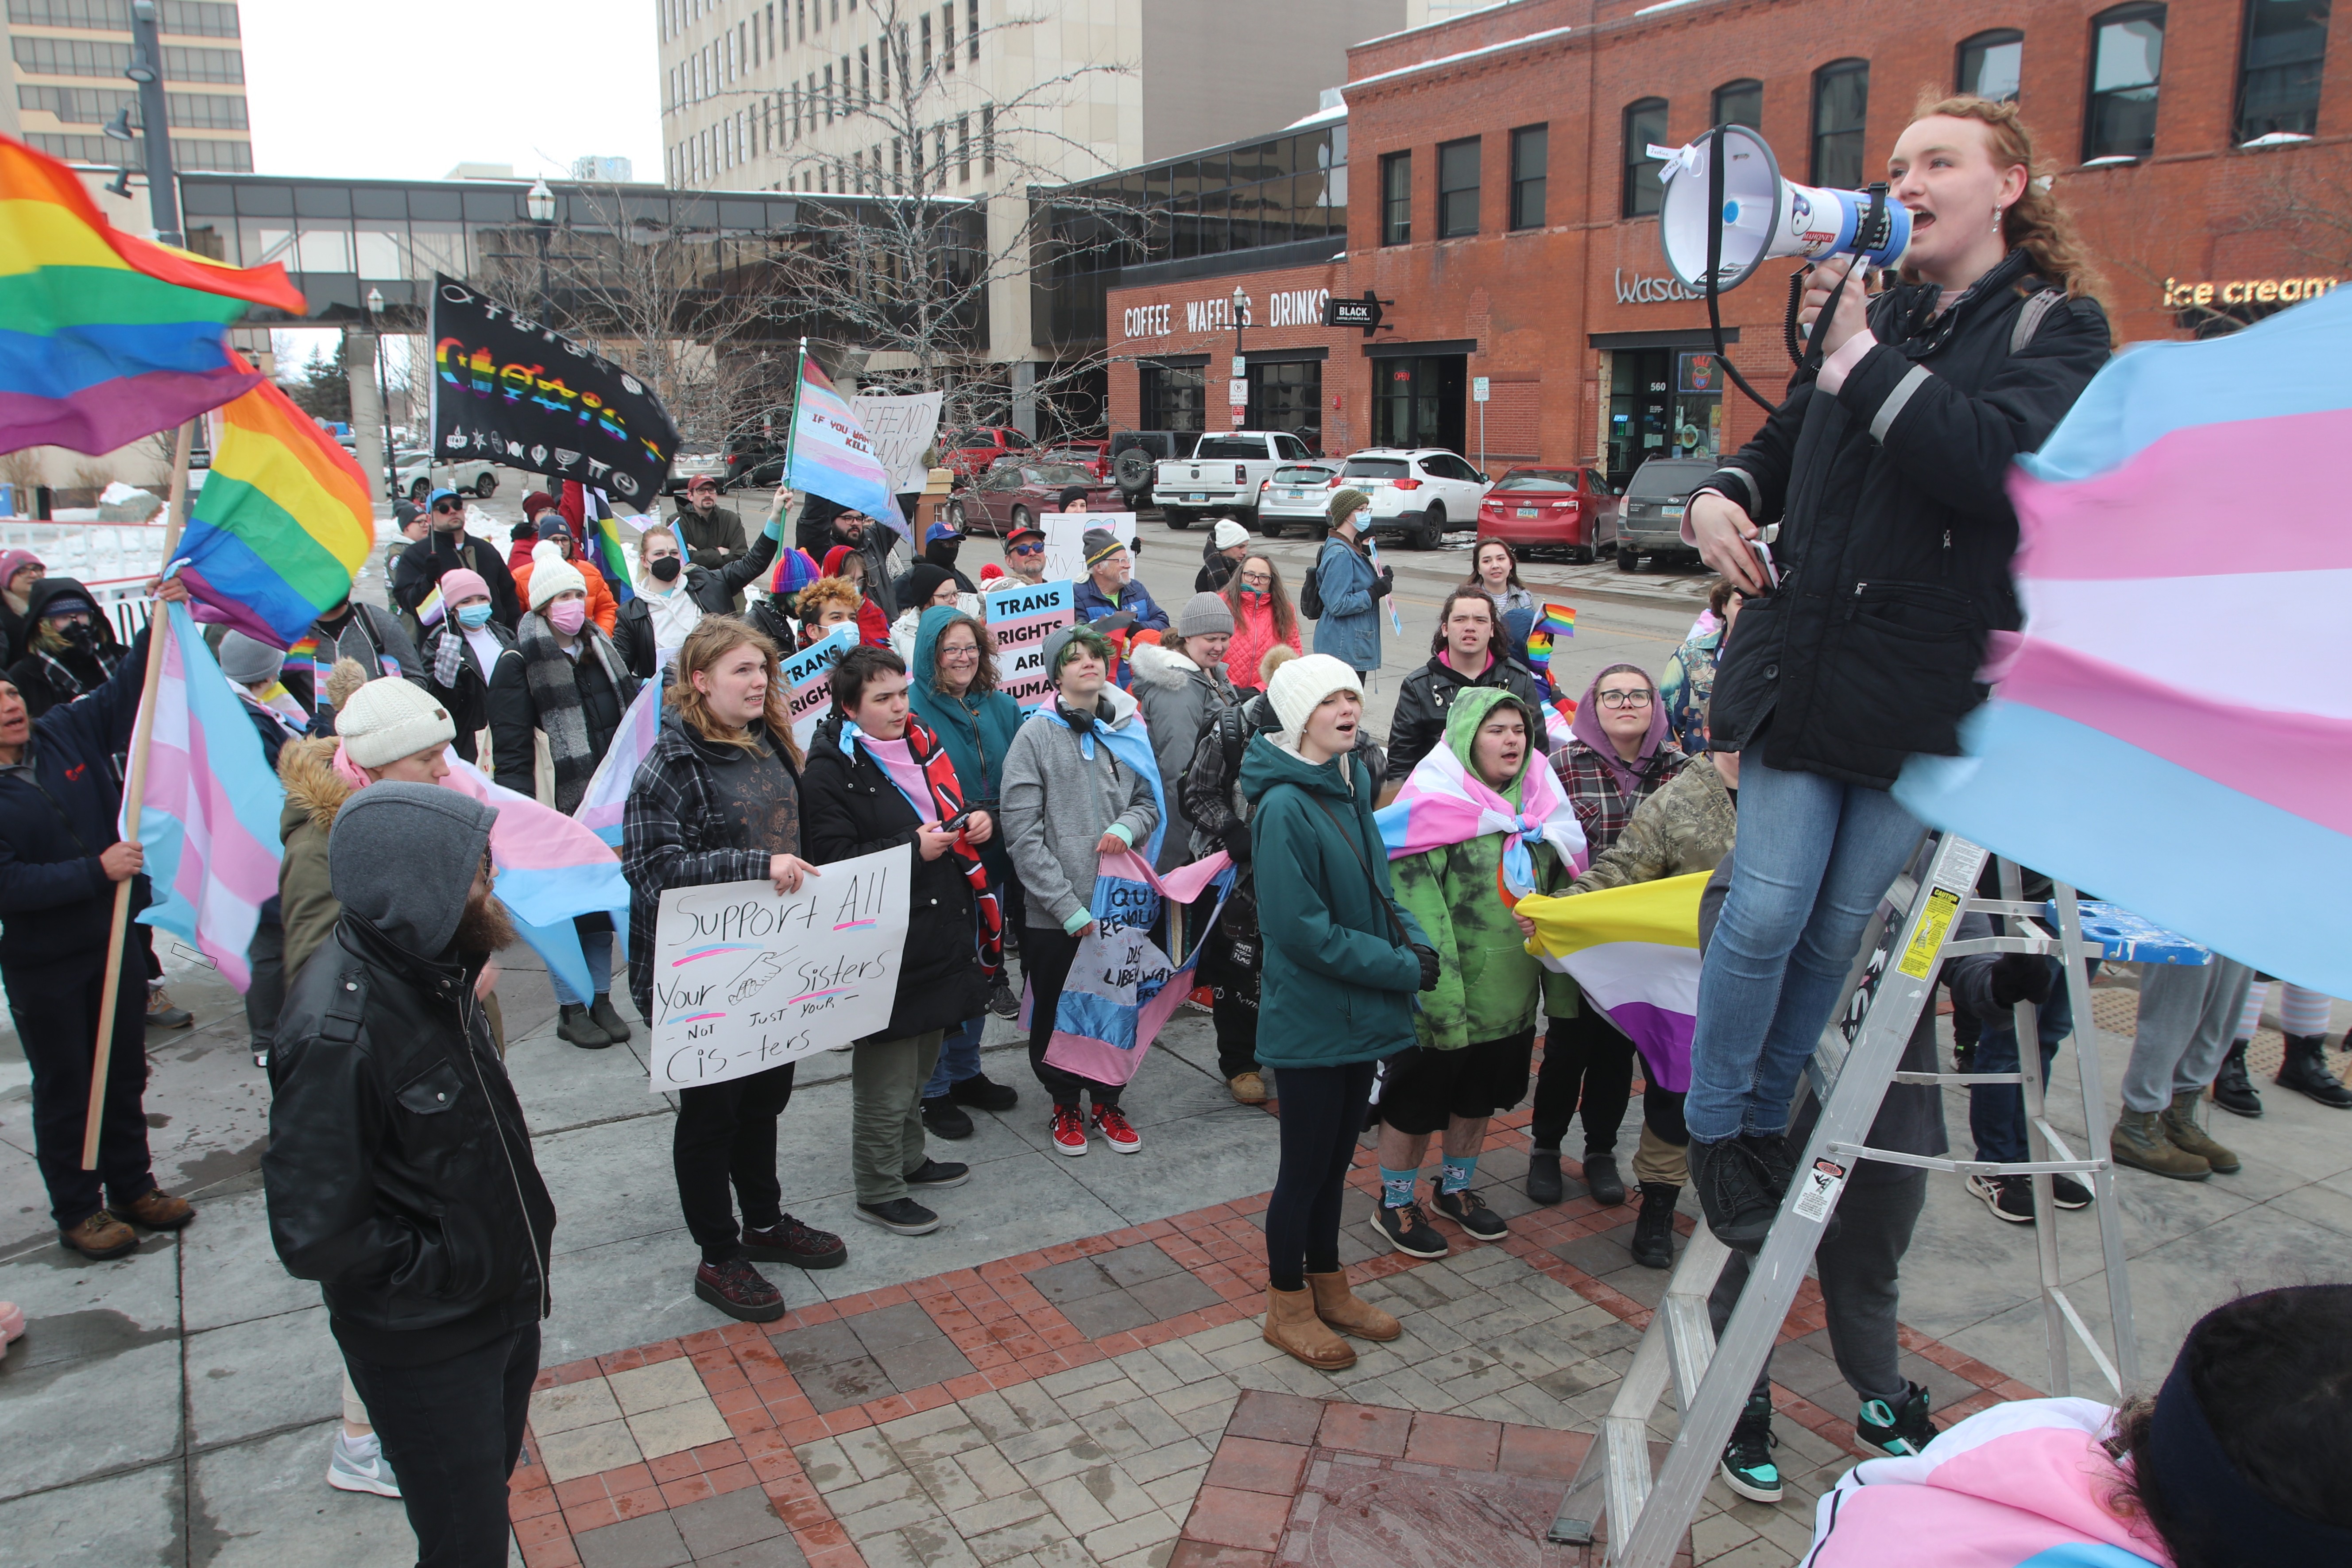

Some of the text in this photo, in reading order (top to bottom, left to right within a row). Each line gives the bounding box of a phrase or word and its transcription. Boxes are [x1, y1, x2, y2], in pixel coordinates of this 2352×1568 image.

[1650, 147, 1669, 156] Justice
[1804, 232, 1835, 242] MAHONEY
[1615, 267, 1706, 304] Wasa
[2163, 277, 2214, 306] ice
[1125, 304, 1171, 337] COFFEE
[1187, 296, 1251, 333] WAFFLS
[1339, 306, 1367, 316] BLACK
[1692, 355, 1712, 367] POKE
[1393, 372, 1410, 380] OPEN
[1650, 383, 1666, 391] 560
[812, 413, 869, 444] IF YOU WAN
[854, 401, 931, 434] DEFEND
[845, 437, 869, 453] KILL
[870, 437, 918, 468] RANS
[1041, 519, 1070, 546] I
[1046, 554, 1074, 578] MY
[996, 592, 1060, 616] TRANS
[789, 681, 832, 716] RIGH
[999, 679, 1054, 699] HUMA
[836, 866, 887, 923] All
[1934, 889, 1958, 902] CAUTION
[1234, 952, 1250, 965] FLAG
[1236, 943, 1252, 952] ANTI
[658, 949, 891, 1026] Your Sisters
[688, 996, 836, 1041] NOT JUST YOUR
[1462, 1483, 1489, 1496] RED
[1493, 1494, 1530, 1518] RIVER
